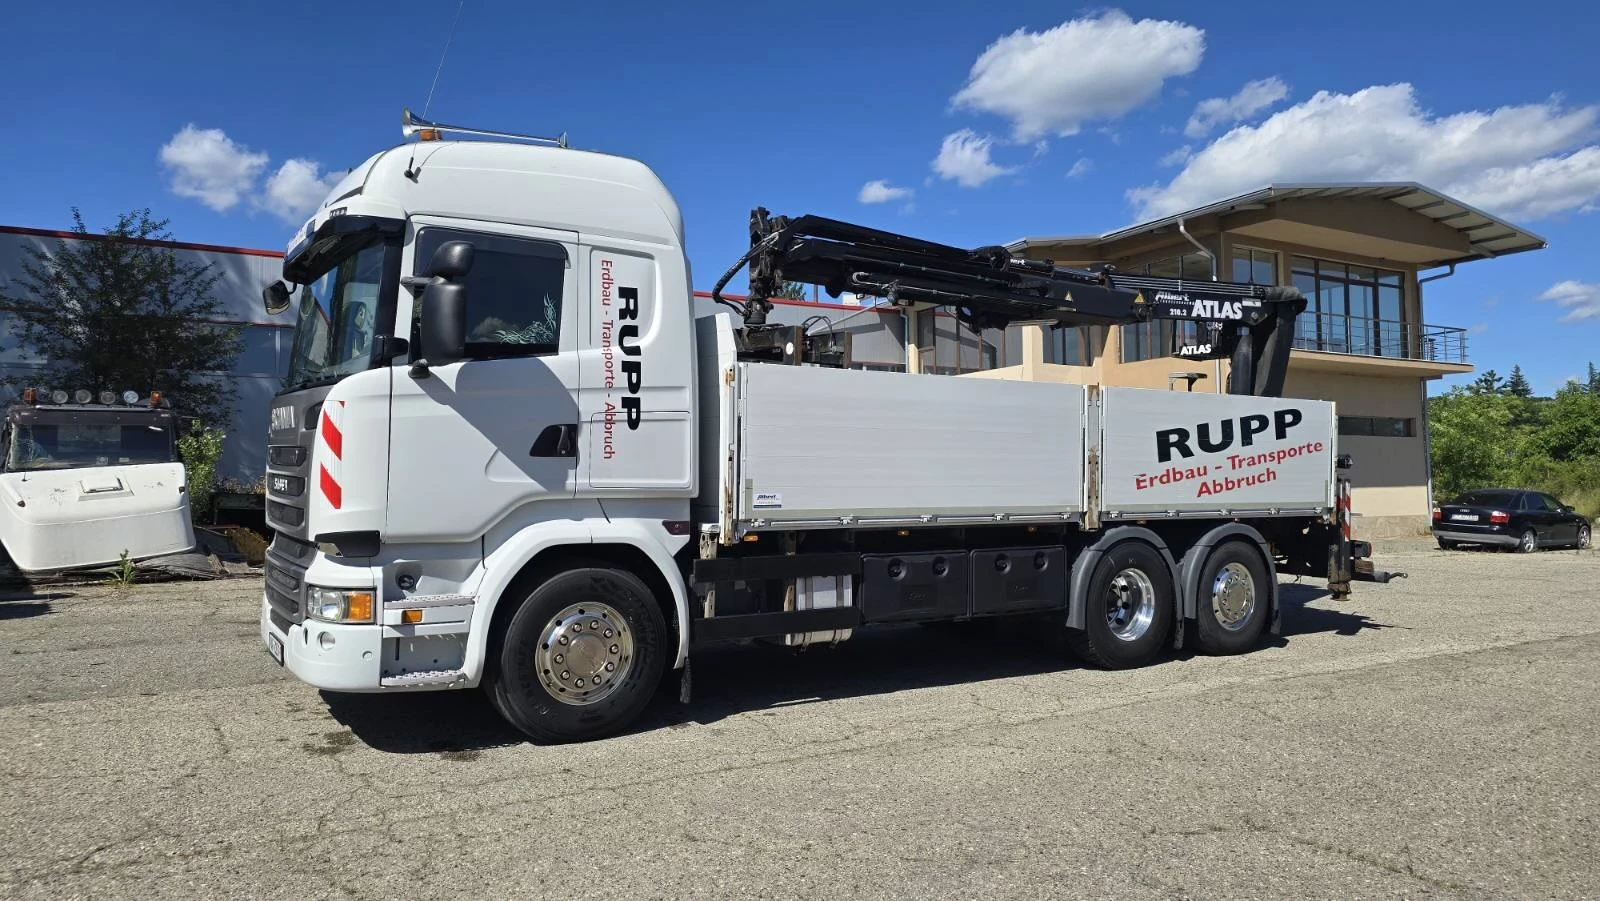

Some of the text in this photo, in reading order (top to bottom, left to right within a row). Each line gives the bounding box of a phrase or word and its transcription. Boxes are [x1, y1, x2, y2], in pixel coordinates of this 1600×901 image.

[601, 260, 613, 306] Erdbau
[1191, 299, 1243, 320] ATLAS
[601, 319, 614, 389] Transporte
[618, 286, 641, 431] RUPP
[1180, 343, 1212, 356] ATLAS
[603, 402, 616, 459] Abbruch
[1156, 408, 1303, 463] RUPP
[1135, 465, 1208, 490] Erdbau
[1226, 442, 1324, 471] Transporte
[1196, 468, 1277, 498] Abbruch
